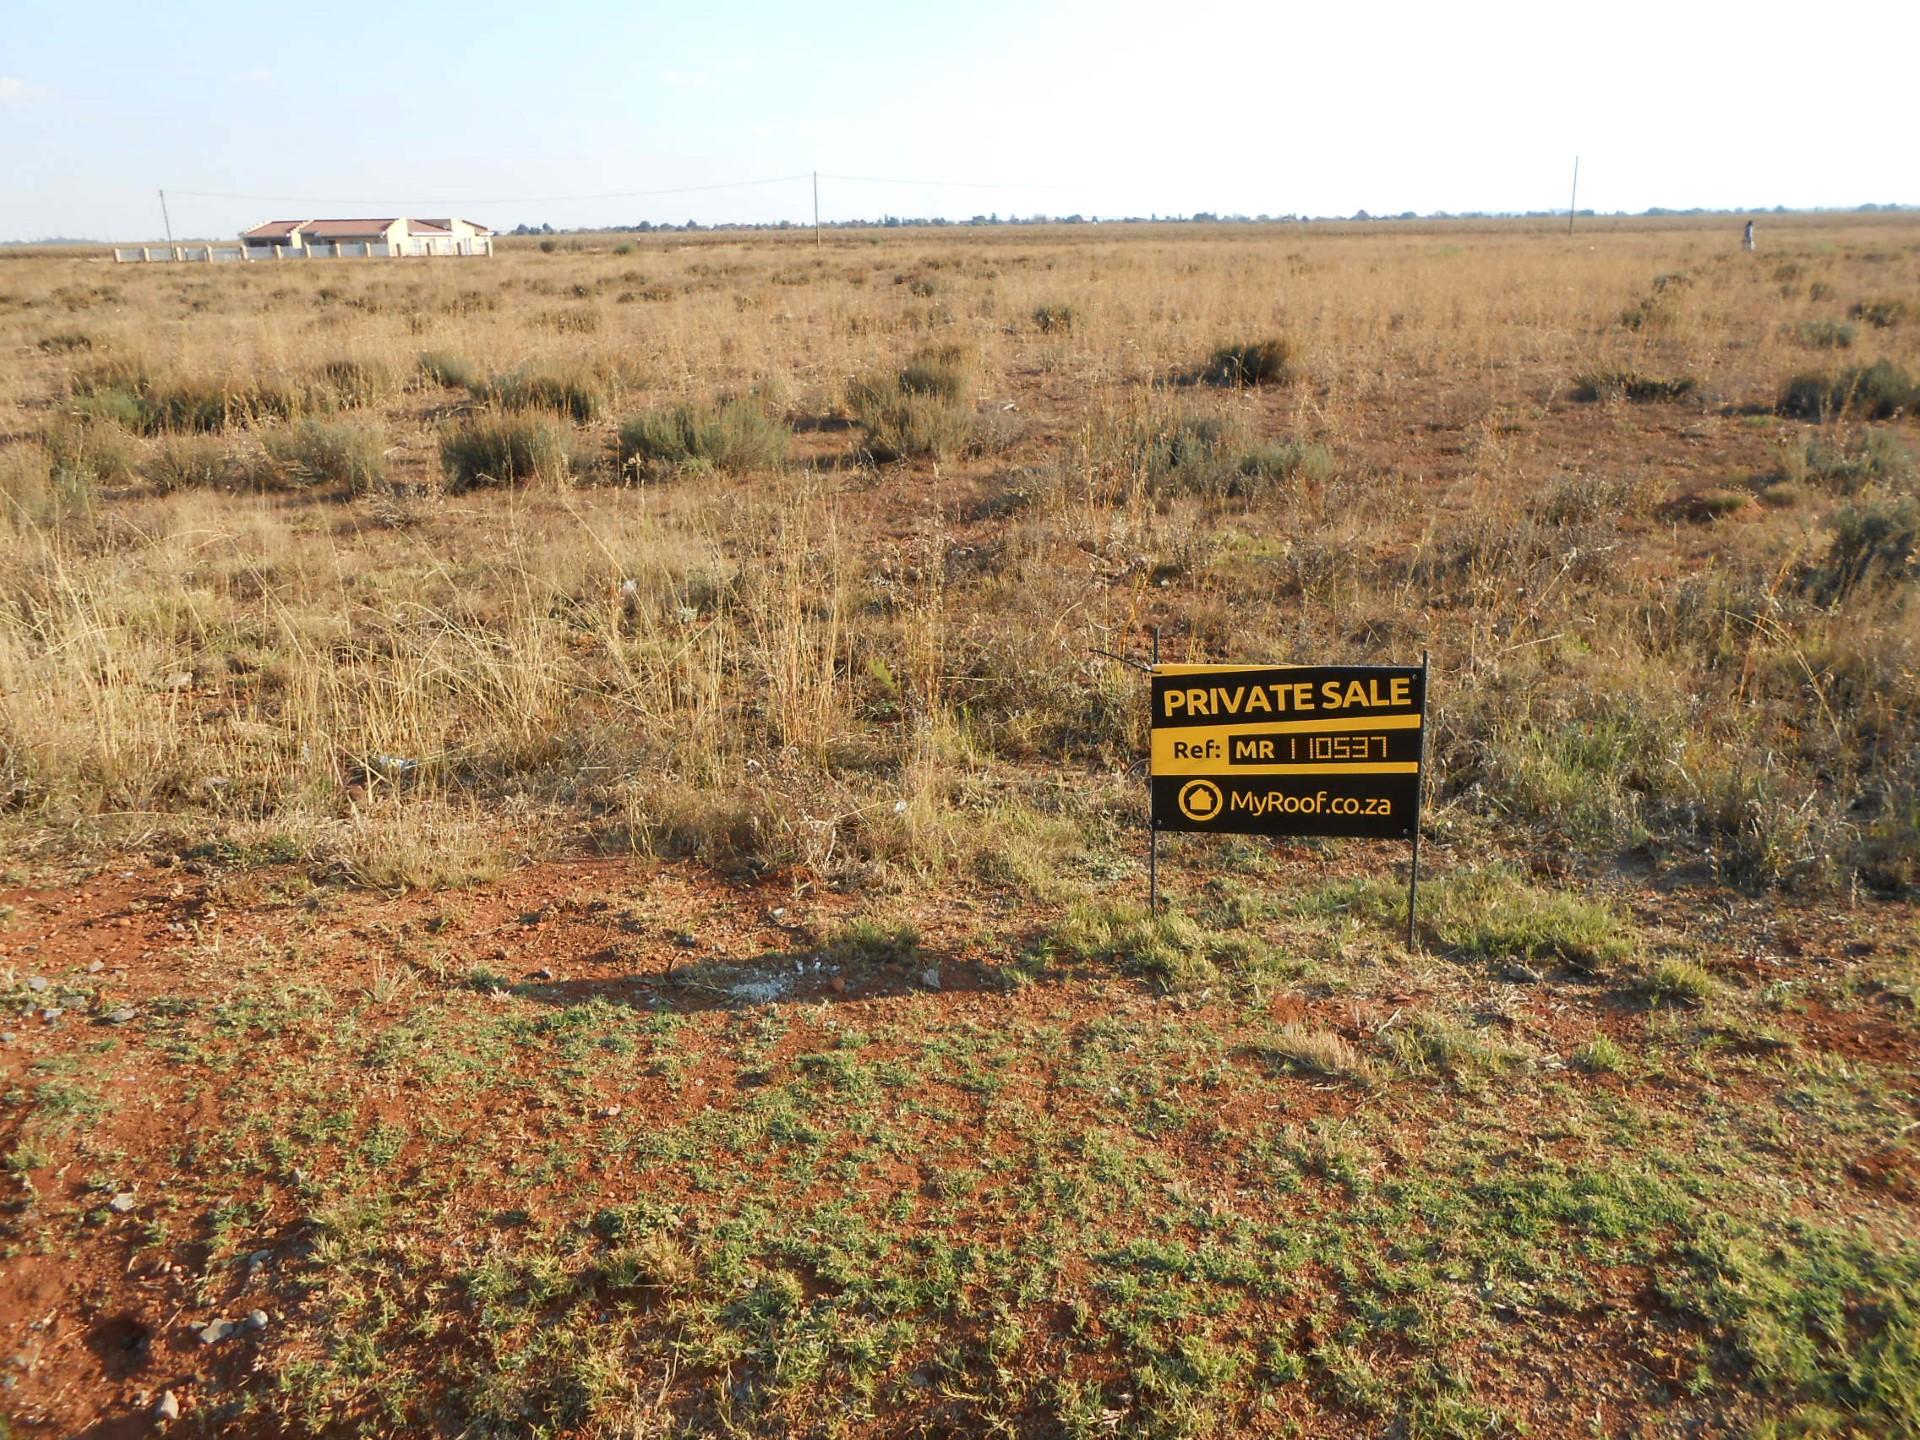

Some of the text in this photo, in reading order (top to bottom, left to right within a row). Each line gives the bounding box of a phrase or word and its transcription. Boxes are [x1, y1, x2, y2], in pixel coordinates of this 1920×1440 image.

[1164, 677, 1412, 717] PRIVATE SALE
[1174, 740, 1221, 760] Ref:
[1235, 740, 1275, 759] MR
[1230, 790, 1391, 817] MyRoof.co.za
